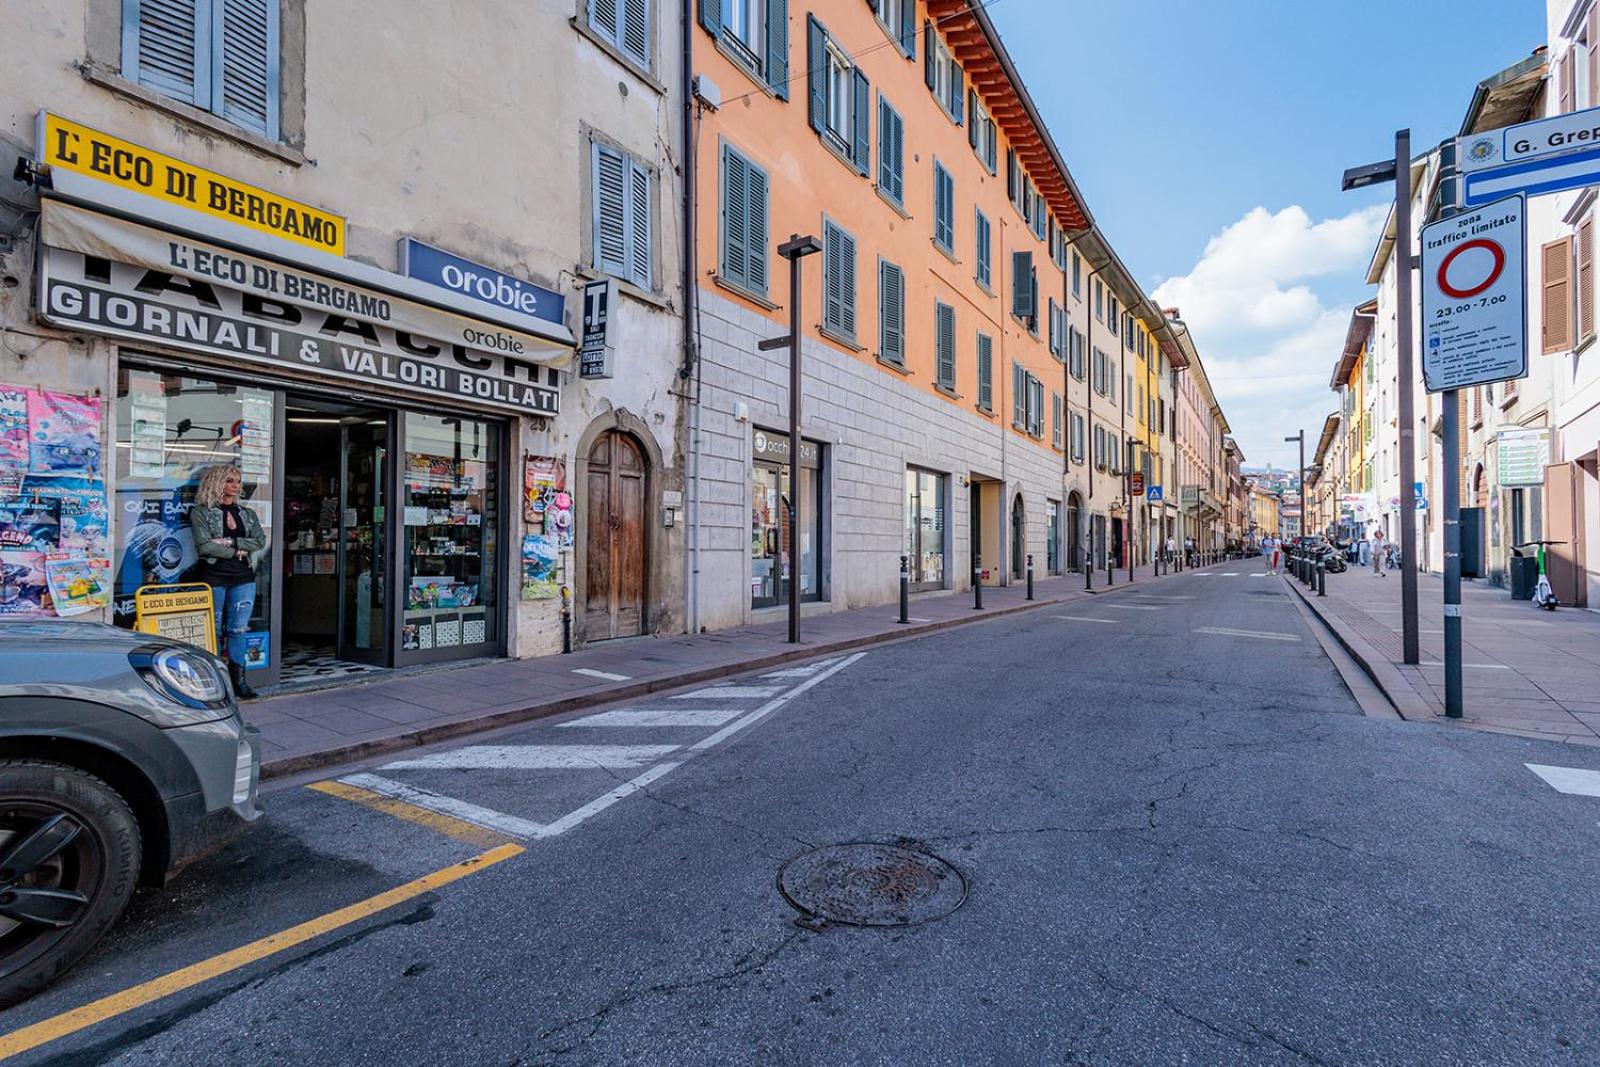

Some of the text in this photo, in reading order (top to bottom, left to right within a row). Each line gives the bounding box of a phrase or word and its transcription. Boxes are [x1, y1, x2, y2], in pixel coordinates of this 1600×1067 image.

[1514, 139, 1538, 154] G.
[166, 166, 196, 202] DI
[208, 180, 338, 247] BERGAMO
[1458, 214, 1482, 228] zona
[1428, 214, 1517, 249] traffico limitato
[169, 242, 391, 321] L'ECO DI BERGAMO
[441, 264, 537, 314] orobie
[587, 284, 607, 327] T
[1436, 304, 1471, 319] 23.00
[1479, 294, 1507, 307] 7.00
[51, 284, 558, 412] GIORNALI & VALORI BOLLATI
[463, 327, 525, 354] orobie
[124, 500, 160, 514] QUI
